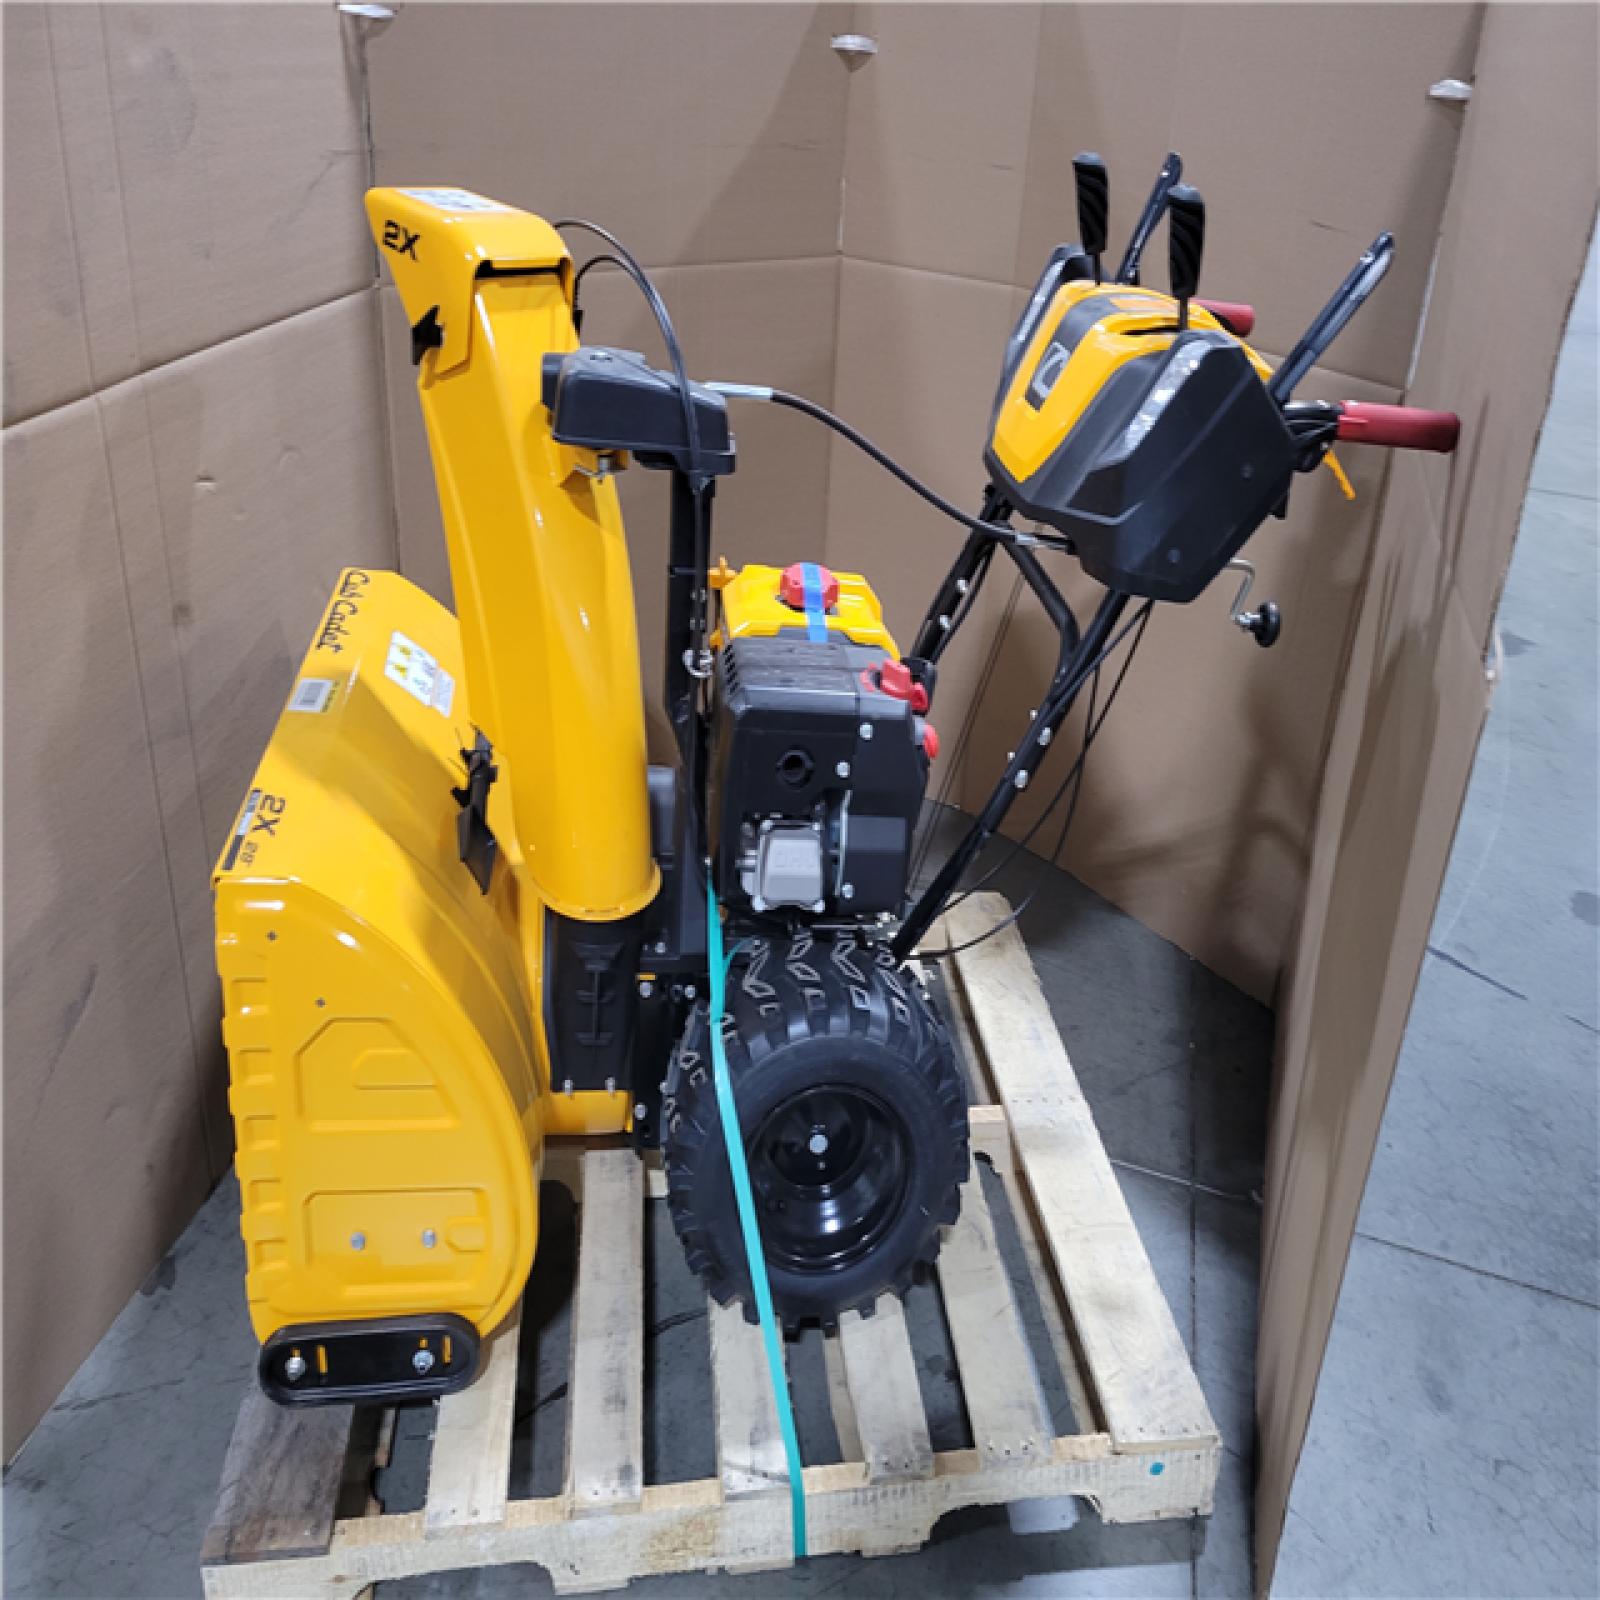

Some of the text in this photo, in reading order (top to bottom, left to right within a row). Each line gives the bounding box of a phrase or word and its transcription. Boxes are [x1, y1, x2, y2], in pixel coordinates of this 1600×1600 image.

[383, 219, 420, 261] 2X
[316, 599, 358, 652] Cadet
[252, 794, 286, 836] 2X
